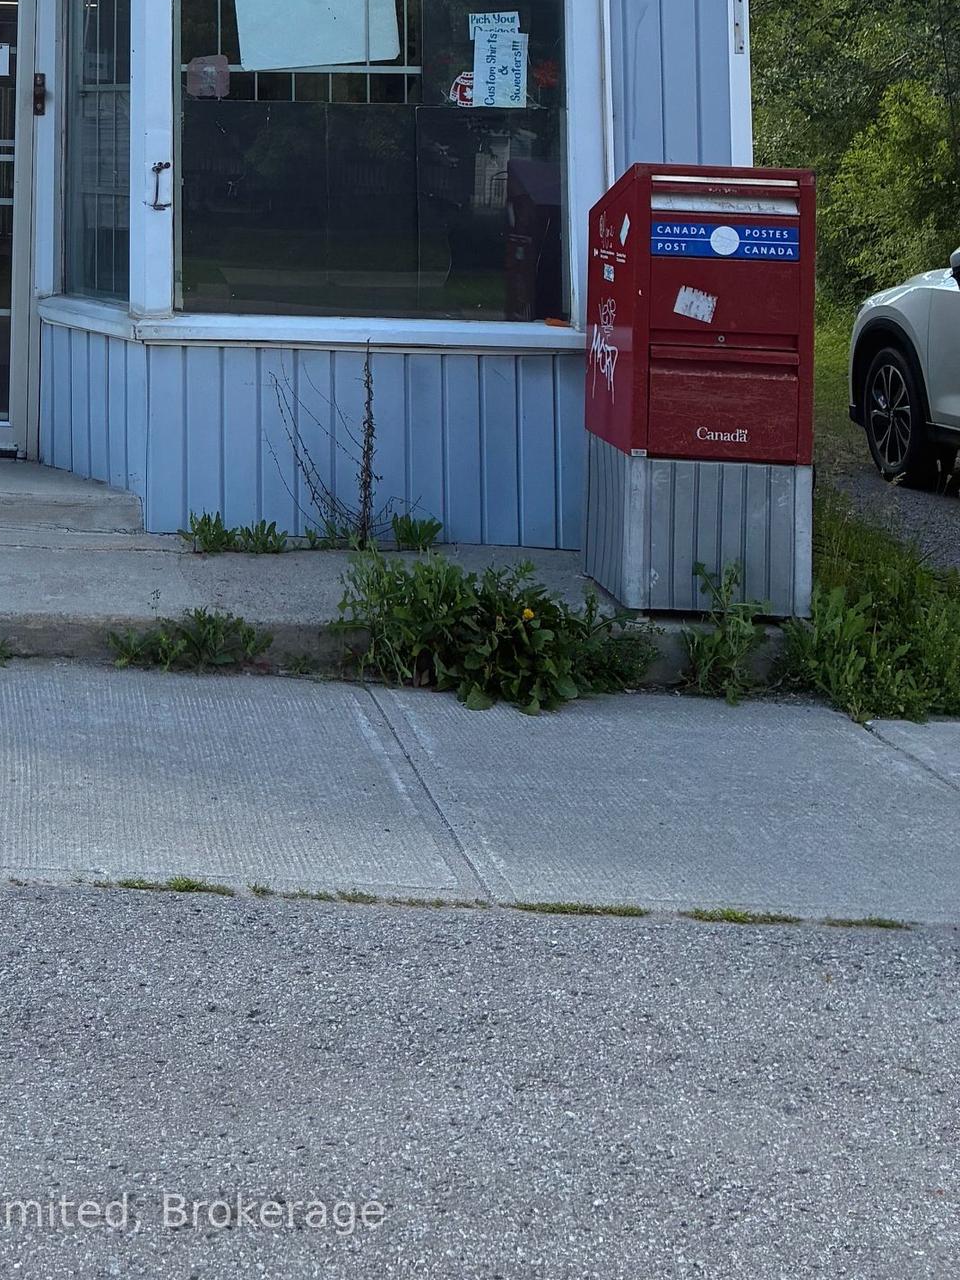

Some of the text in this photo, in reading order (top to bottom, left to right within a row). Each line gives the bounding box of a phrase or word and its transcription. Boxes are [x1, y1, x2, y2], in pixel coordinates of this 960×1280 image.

[484, 33, 497, 106] Custom Shirts
[498, 65, 509, 76] &
[656, 225, 707, 235] CANADA
[745, 228, 789, 239] POSTES
[657, 242, 688, 251] POST
[744, 245, 794, 256] CANADA
[696, 425, 748, 443] Canada
